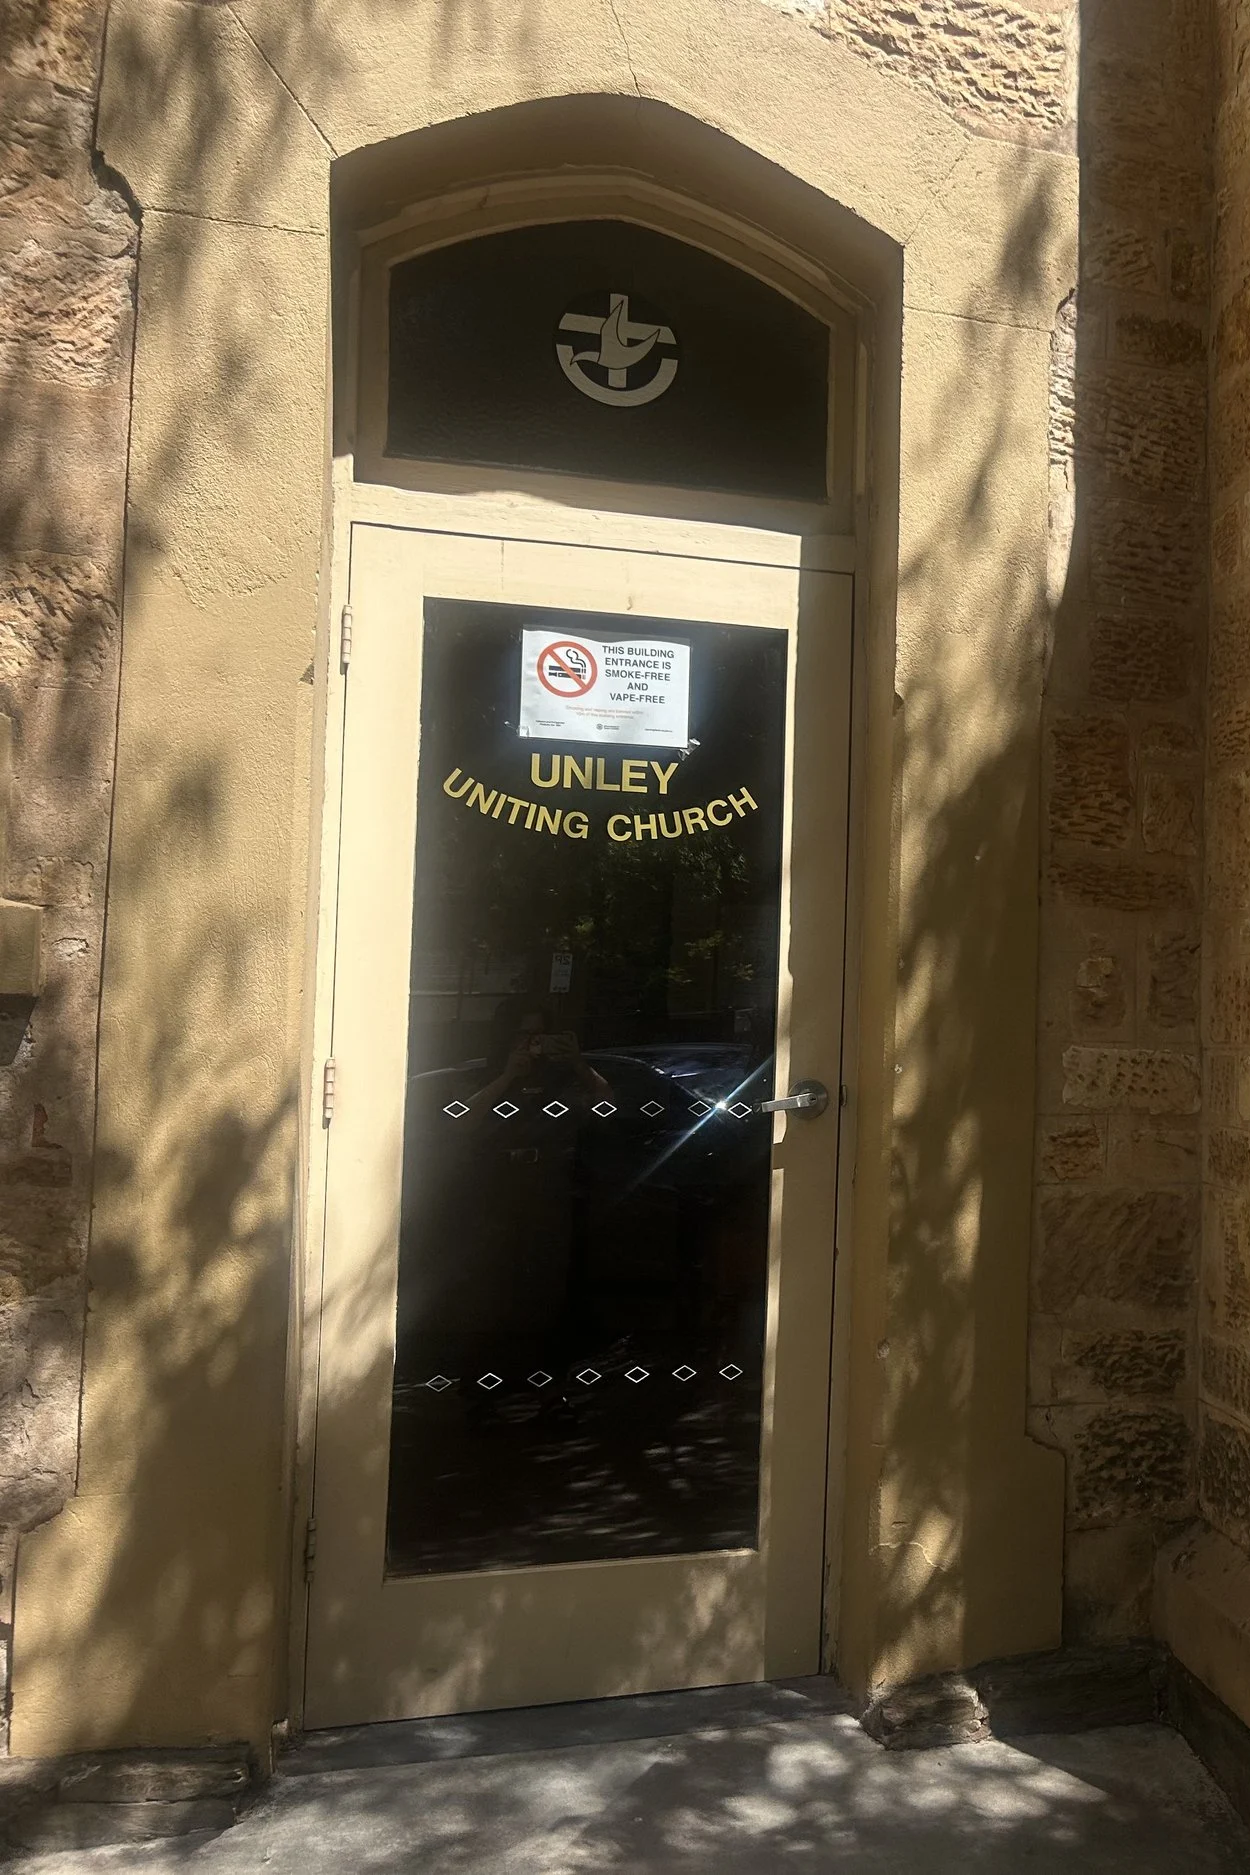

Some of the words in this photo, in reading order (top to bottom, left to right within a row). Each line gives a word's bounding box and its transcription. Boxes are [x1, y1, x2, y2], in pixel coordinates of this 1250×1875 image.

[602, 645, 625, 655] THIS
[627, 647, 675, 659] BUILDING
[605, 657, 660, 669] ENTRANCE
[662, 661, 672, 670] IS
[604, 669, 671, 682] SMOKE-FREE
[627, 682, 649, 691] AND
[609, 692, 666, 704] VAPE-FREE
[530, 752, 679, 795] UNLEY
[442, 767, 590, 840] UNITING
[606, 786, 759, 842] CHURCH
